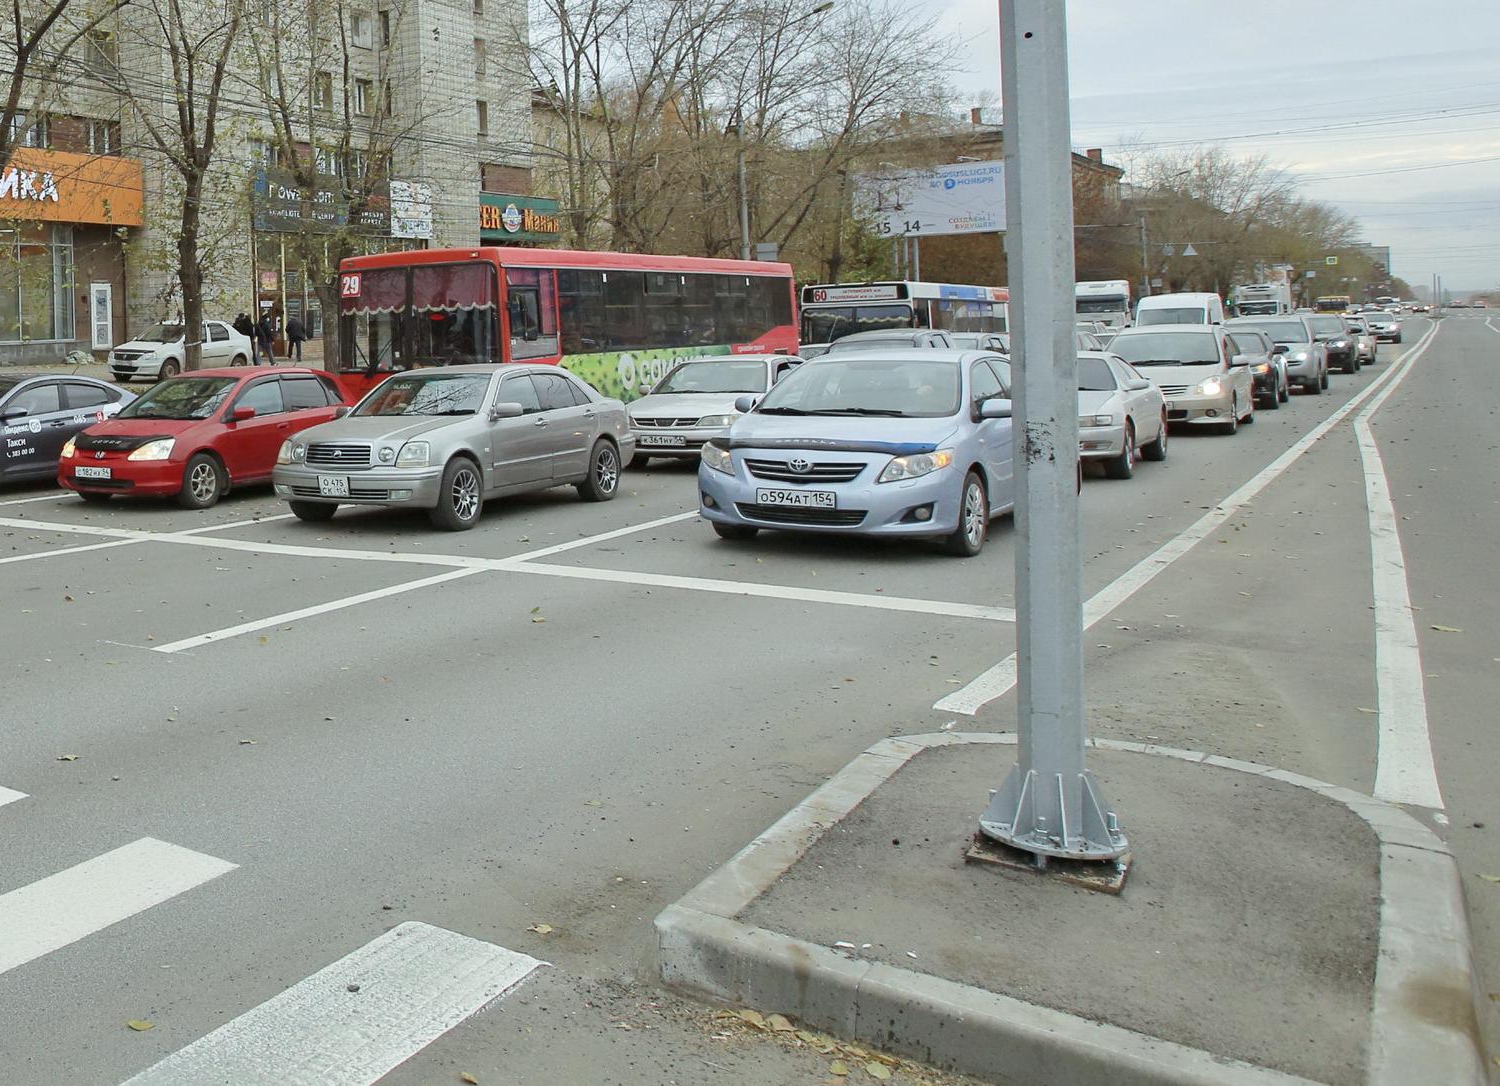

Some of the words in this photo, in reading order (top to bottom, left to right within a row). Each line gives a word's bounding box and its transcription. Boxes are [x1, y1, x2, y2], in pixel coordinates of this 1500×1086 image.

[478, 205, 501, 229] ER
[903, 220, 921, 232] 14
[343, 276, 359, 295] 29
[815, 290, 827, 301] 60
[4, 424, 29, 435] Яндекс
[6, 438, 26, 448] Такси
[813, 493, 832, 502] 154
